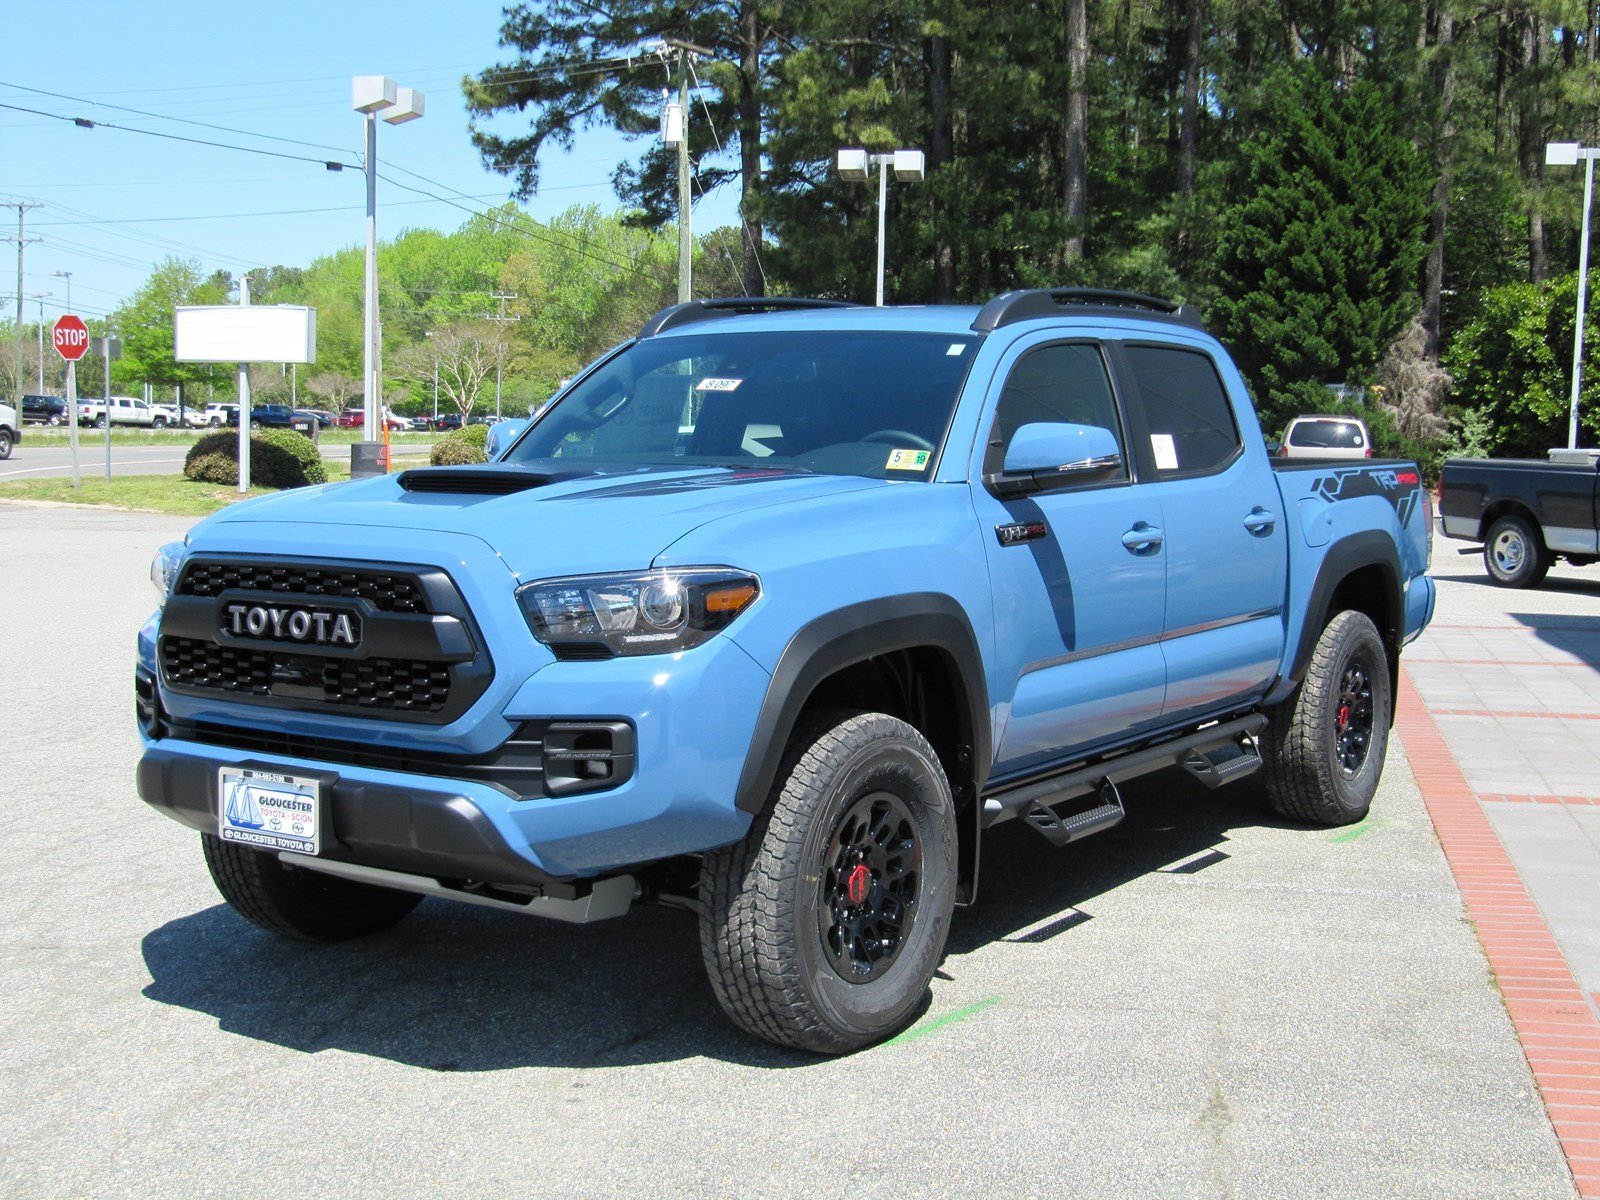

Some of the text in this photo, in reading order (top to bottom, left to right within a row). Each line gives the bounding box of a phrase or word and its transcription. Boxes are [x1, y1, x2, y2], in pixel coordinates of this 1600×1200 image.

[55, 328, 86, 346] STOP
[894, 451, 902, 462] 5
[916, 454, 926, 464] 19
[228, 605, 355, 643] TOYOTA
[259, 796, 312, 811] GLOUCESTER
[260, 808, 313, 823] TOYOTA SCION
[234, 831, 304, 850] GLOUCESTER TOYOTA
